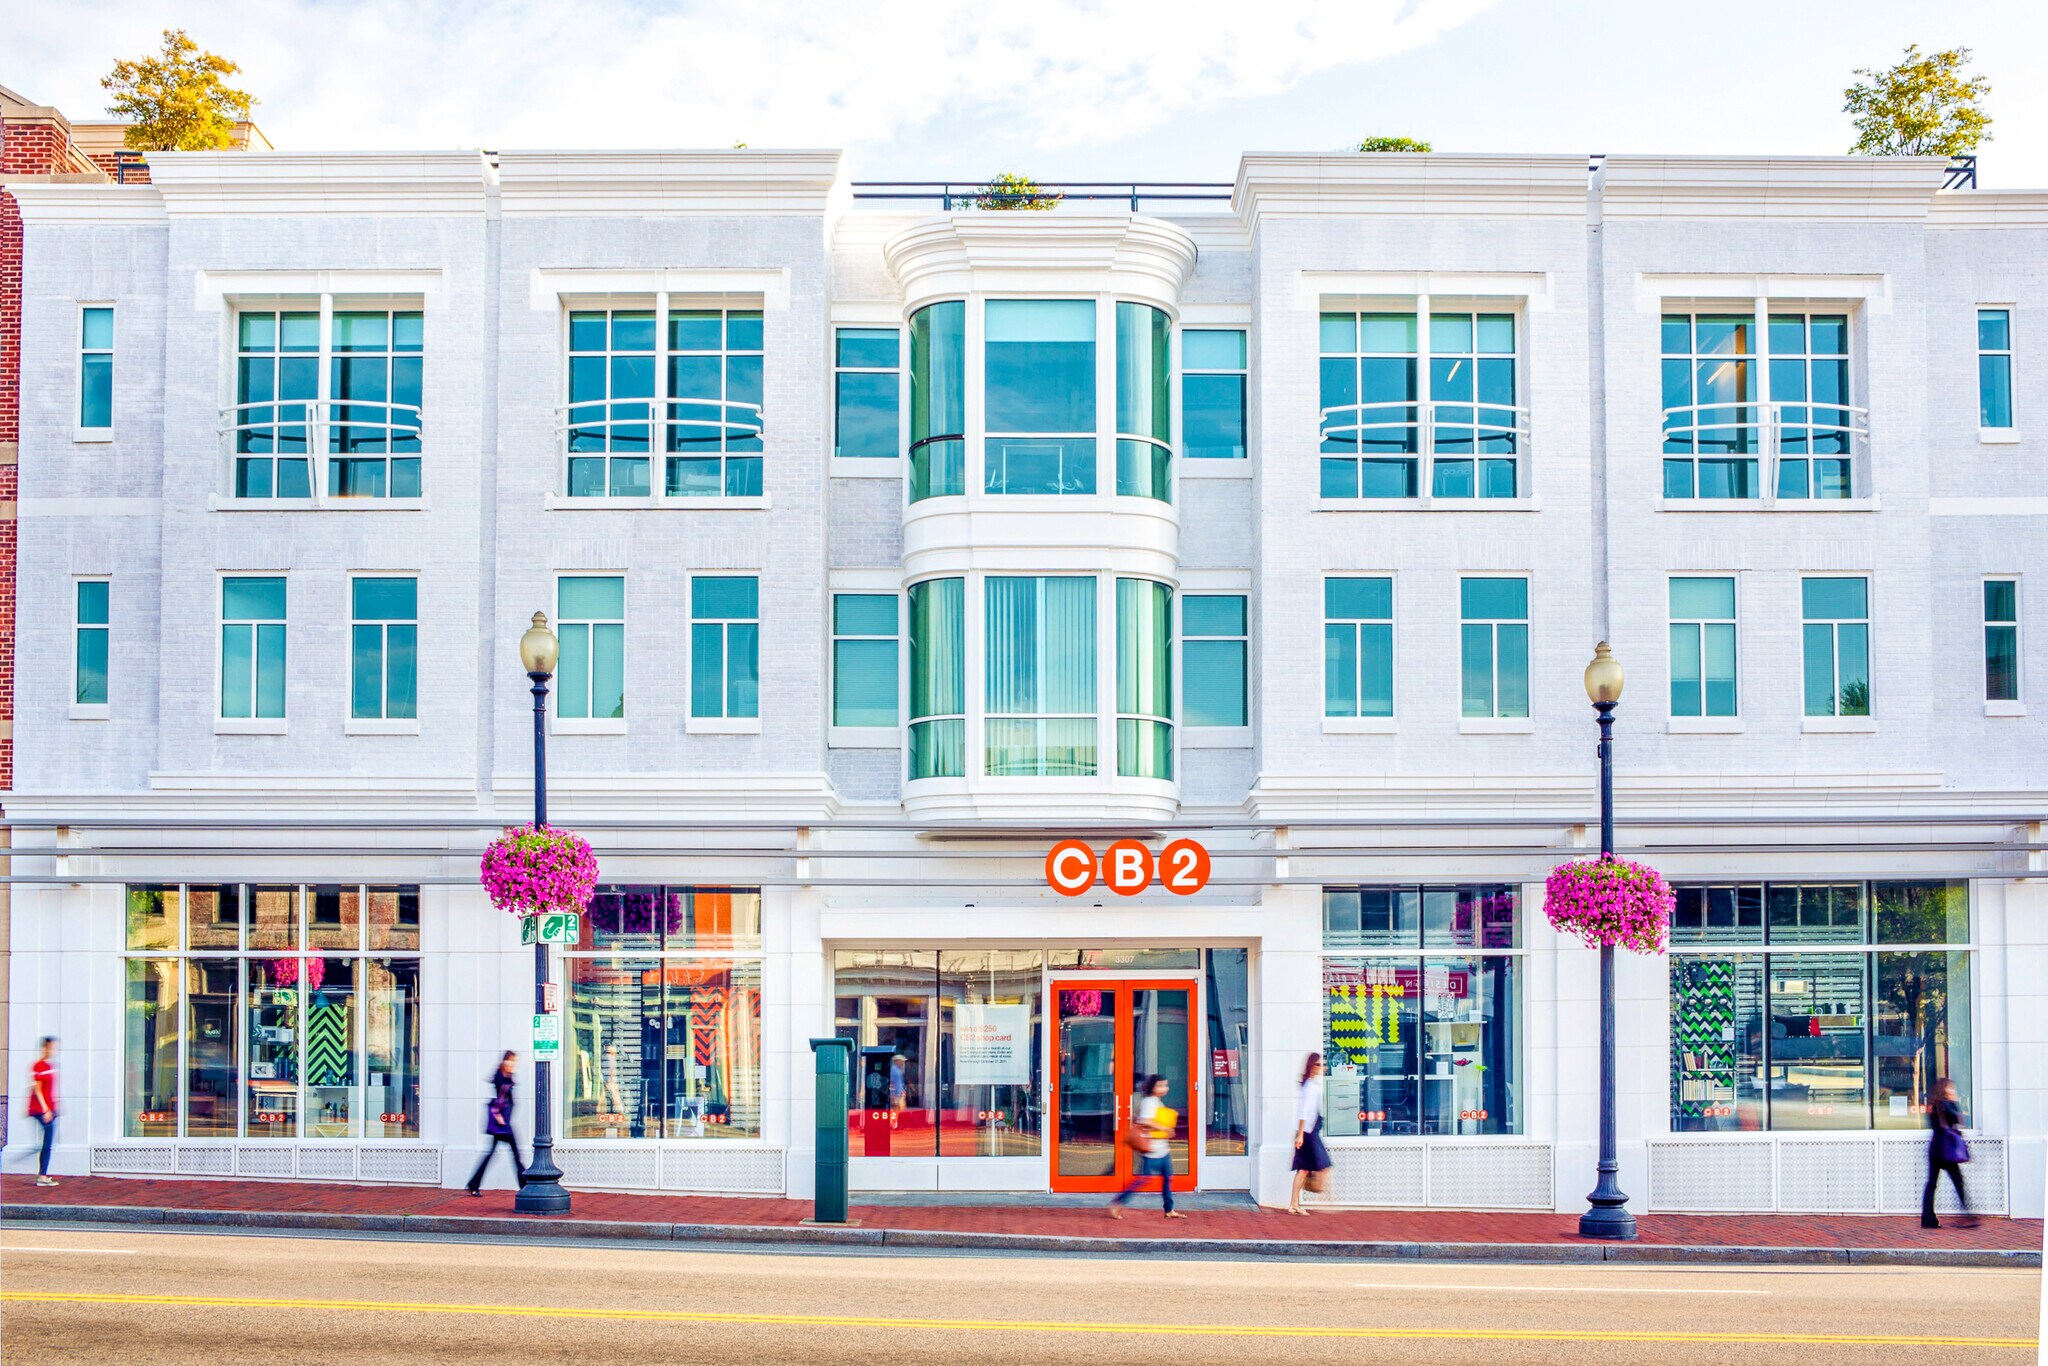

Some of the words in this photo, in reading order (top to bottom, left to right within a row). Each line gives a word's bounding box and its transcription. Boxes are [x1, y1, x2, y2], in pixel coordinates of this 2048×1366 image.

[1051, 846, 1200, 890] CB2
[567, 915, 576, 927] 2
[1115, 955, 1135, 963] 3307
[977, 1034, 994, 1043] shop
[1359, 1112, 1384, 1120] CB2
[1461, 1111, 1486, 1119] CB2
[1704, 1107, 1729, 1116] CB2
[140, 1113, 164, 1122] CB2
[260, 1113, 285, 1122] CB2
[381, 1113, 405, 1122] CB2
[701, 1115, 725, 1123] CB2
